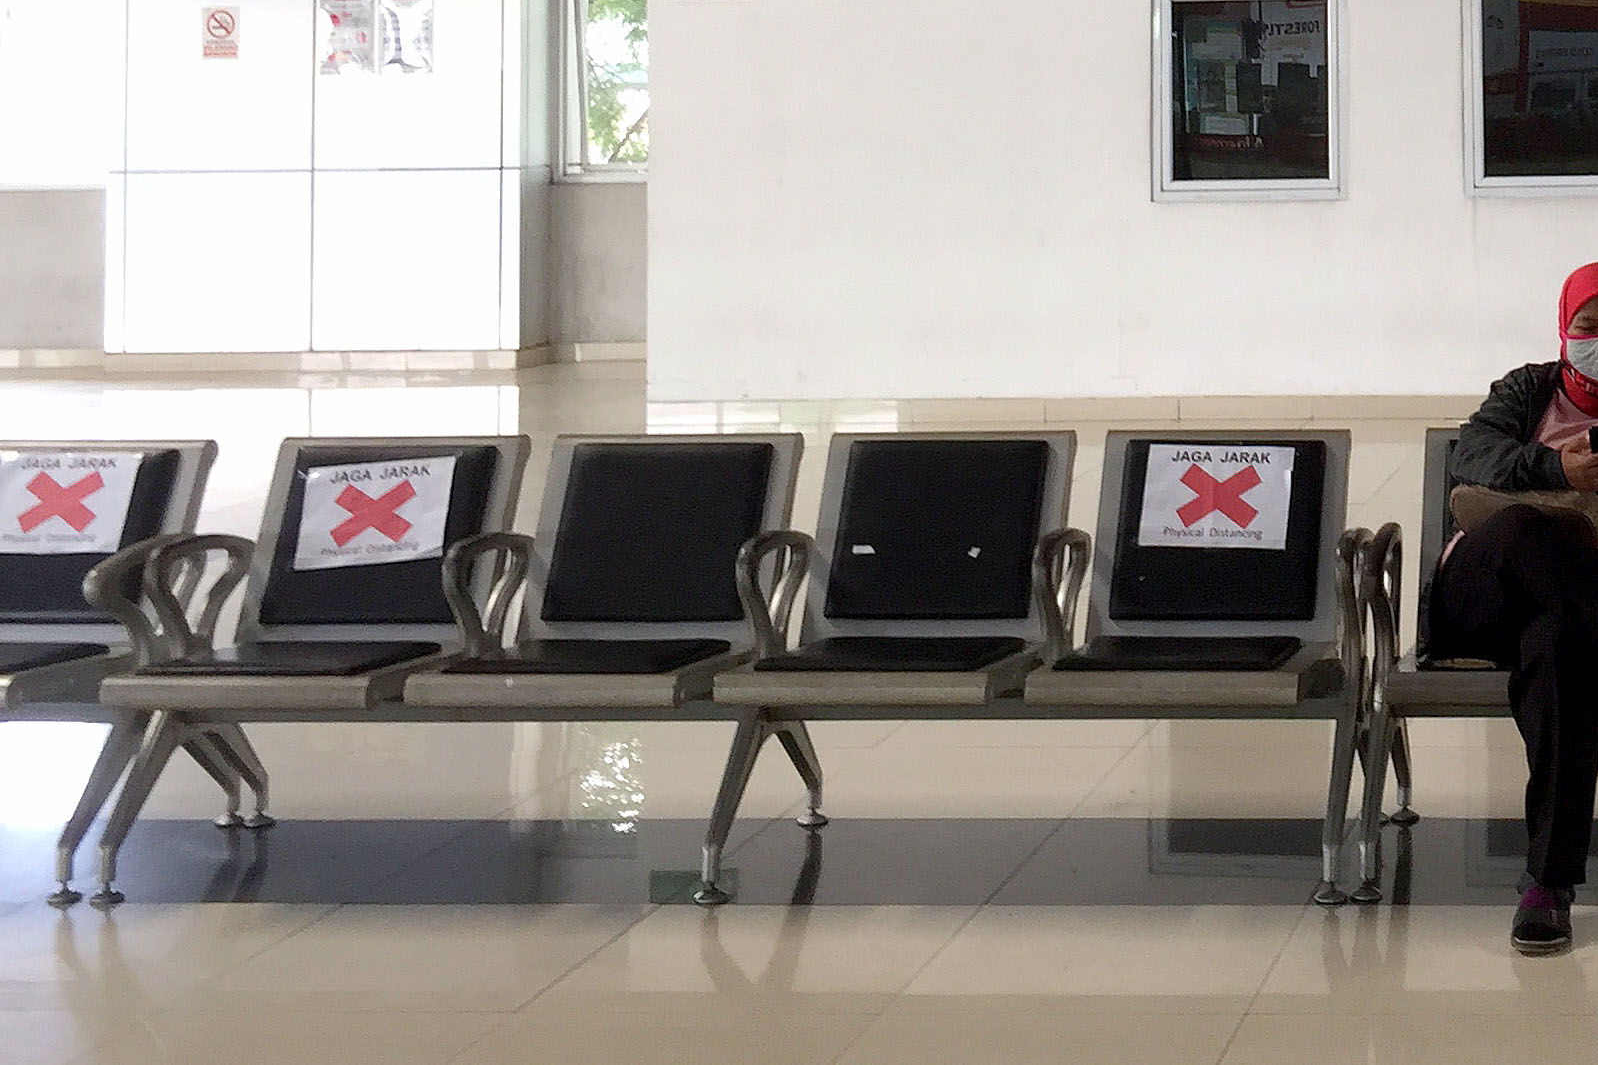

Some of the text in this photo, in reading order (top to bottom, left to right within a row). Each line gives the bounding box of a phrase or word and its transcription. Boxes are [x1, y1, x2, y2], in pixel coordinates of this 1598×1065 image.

[1171, 451, 1271, 464] JAGA JARAK
[330, 465, 431, 484] JAGA JARAK
[1162, 526, 1263, 541] Physical Distancing
